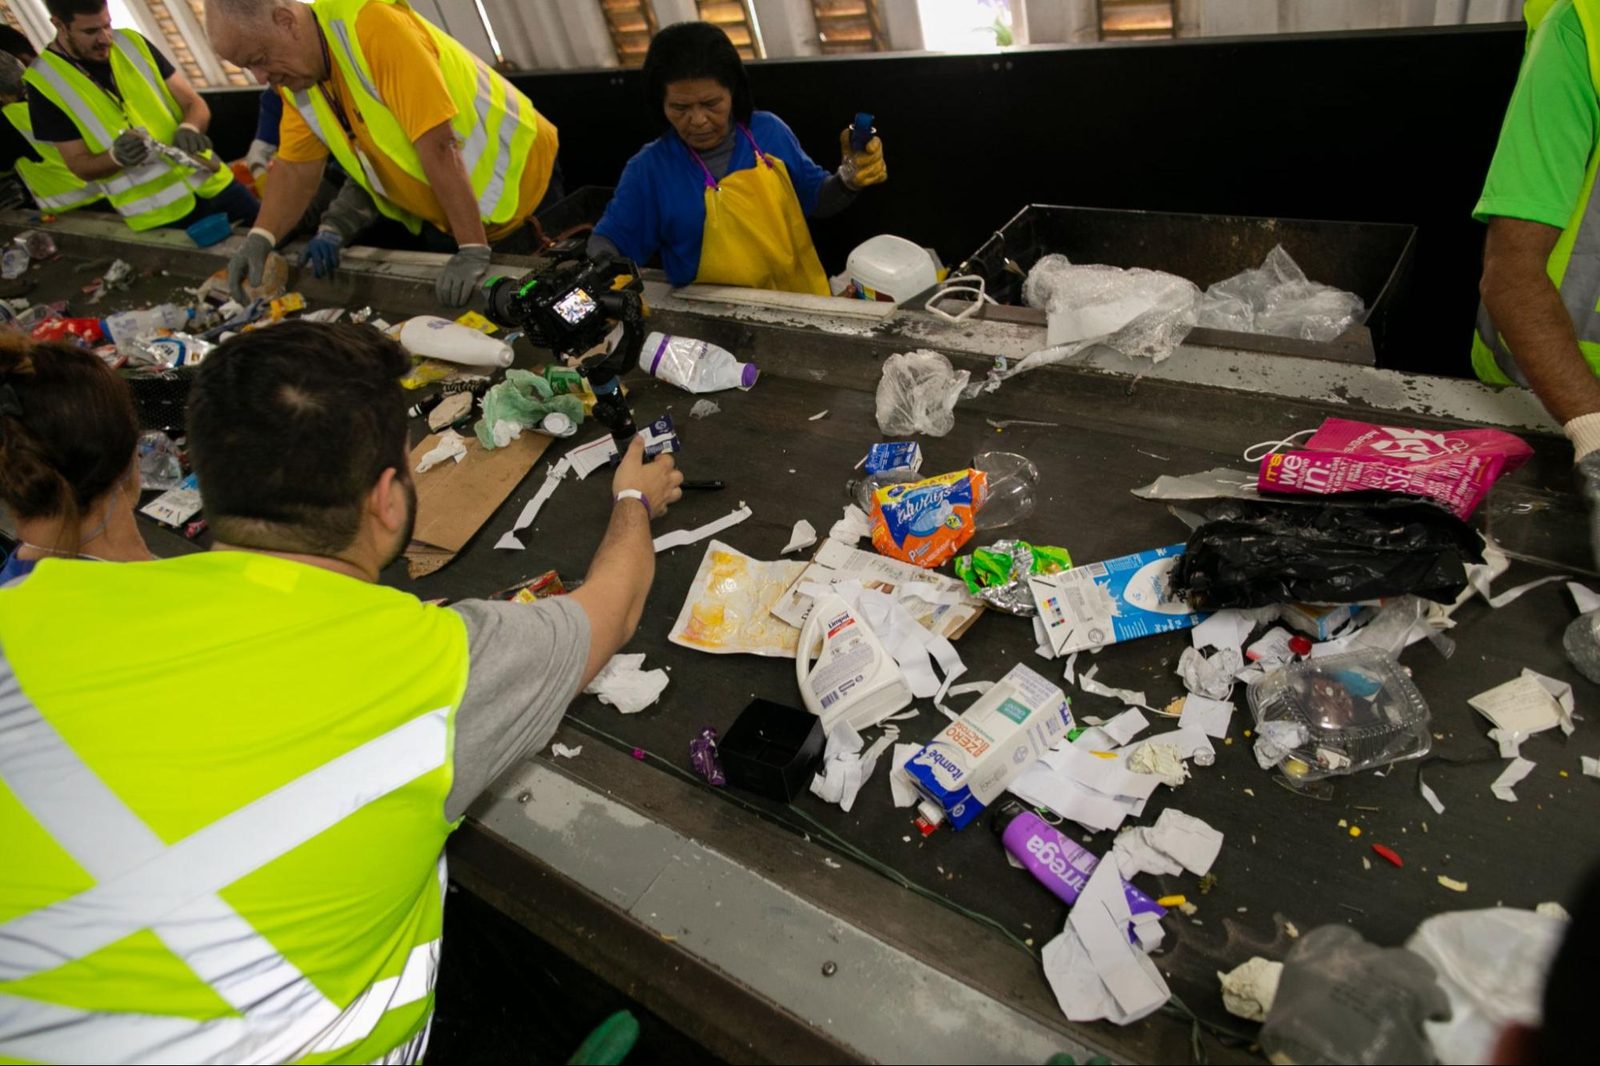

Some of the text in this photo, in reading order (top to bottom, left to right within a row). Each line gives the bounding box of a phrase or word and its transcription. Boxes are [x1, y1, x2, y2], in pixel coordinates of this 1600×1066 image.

[1266, 453, 1283, 482] IT'S
[1278, 455, 1302, 485] we
[1303, 461, 1331, 494] in:
[946, 727, 978, 753] ZERO
[926, 749, 964, 781] itambé
